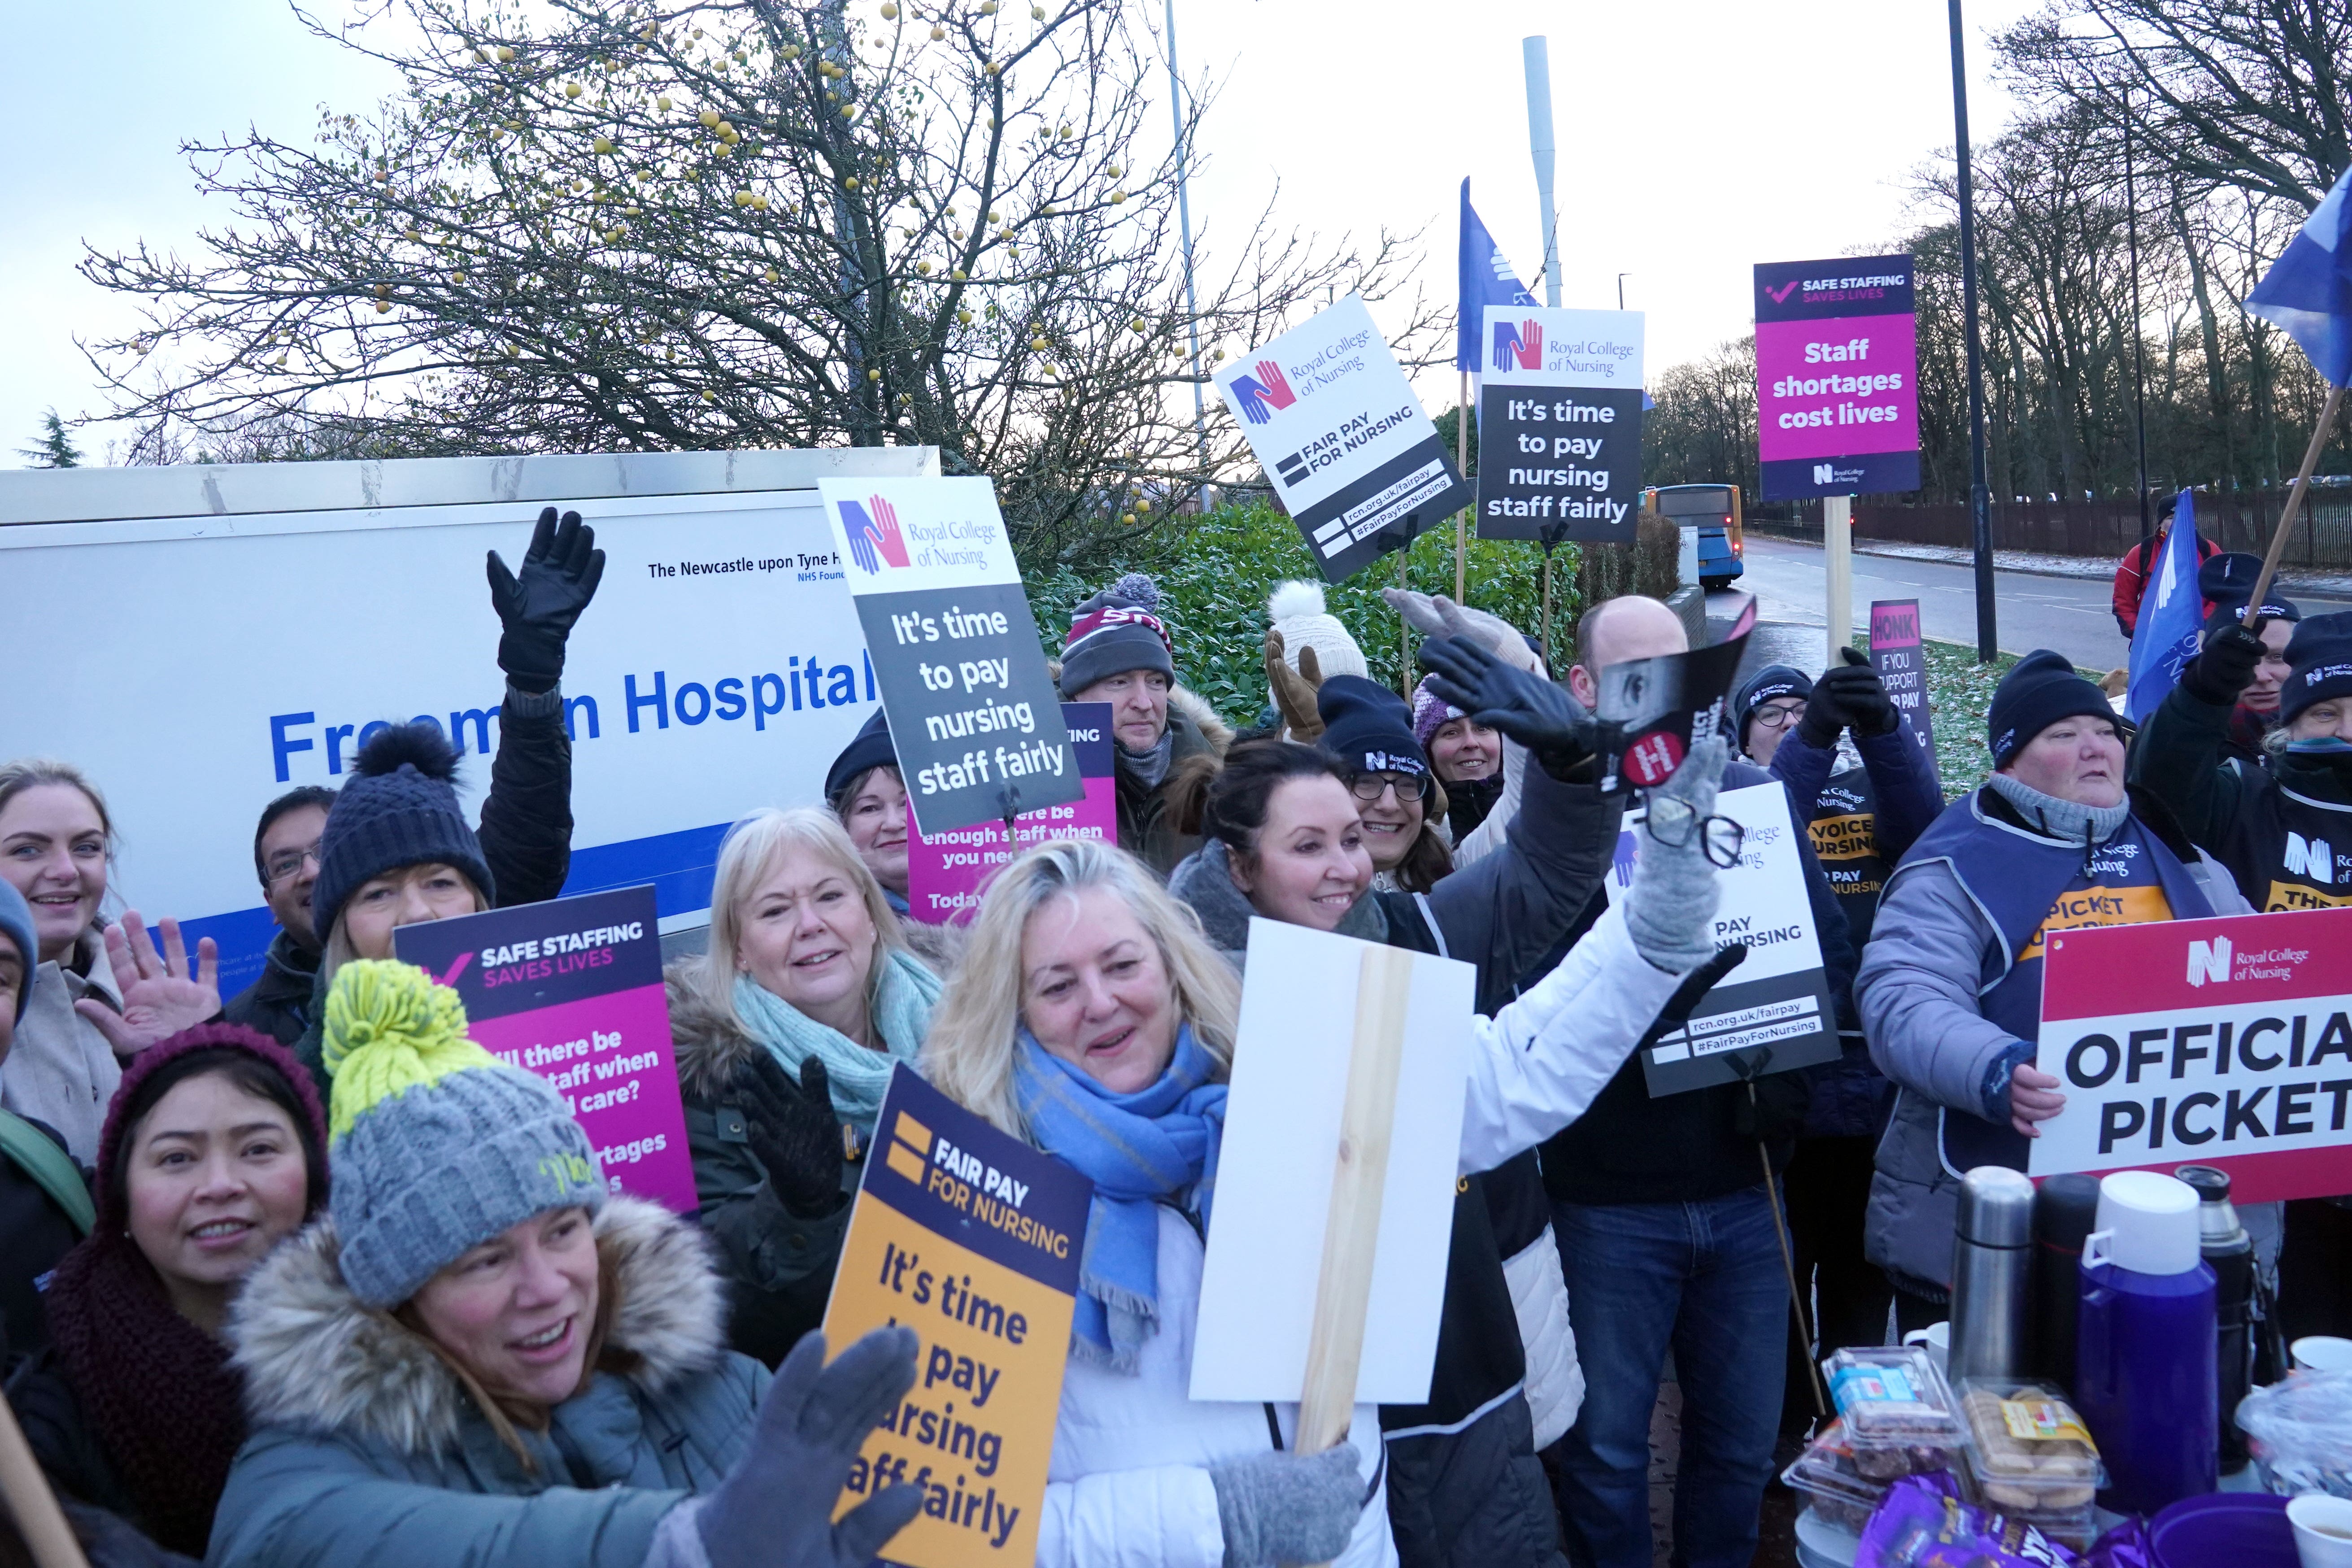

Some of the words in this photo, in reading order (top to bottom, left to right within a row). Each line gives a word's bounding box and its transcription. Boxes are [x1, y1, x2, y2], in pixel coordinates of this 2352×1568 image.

[1803, 279, 1838, 291] SAFE
[1840, 274, 1905, 289] STAFFING
[1803, 291, 1844, 303] SAVES
[1848, 288, 1884, 300] LIVES
[1291, 352, 1326, 380] Royal
[1326, 330, 1371, 359] College
[1551, 341, 1584, 359] Royal
[1588, 342, 1633, 360] College
[1804, 338, 1870, 364] Staff
[1302, 379, 1315, 396] of
[1315, 356, 1364, 388] Nursing
[1549, 359, 1561, 371] of
[1567, 360, 1614, 377] Nursing
[1773, 373, 1902, 398] shortages
[1508, 400, 1546, 421] It's
[1554, 400, 1615, 423] time
[1779, 406, 1833, 429] cost
[1838, 401, 1898, 425] lives
[1303, 432, 1339, 459] FAIR
[1340, 412, 1369, 437] PAY
[1310, 448, 1342, 473] FOR
[1344, 406, 1413, 452] NURSING
[1518, 434, 1546, 453] to
[1554, 437, 1603, 459] pay
[1509, 464, 1609, 492] nursing
[1348, 469, 1430, 520] rcn.org.uk/fairpay
[1356, 479, 1447, 536] #FairPayForNursing
[1488, 496, 1553, 517] staff
[1559, 496, 1629, 524] fairly
[908, 522, 947, 547] Royal
[950, 521, 996, 544] College
[649, 564, 675, 578] The
[681, 557, 754, 575] Newcastle
[759, 557, 793, 573] upon
[797, 554, 828, 570] Tyne
[918, 549, 932, 567] of
[934, 547, 988, 570] Nursing
[797, 572, 817, 582] NHS
[891, 610, 940, 645] It's
[942, 605, 1009, 639] time
[1874, 614, 1916, 641] HONK
[919, 662, 953, 691] to
[959, 658, 1009, 693] pay
[1882, 655, 1889, 671] IF
[1890, 653, 1909, 669] YOU
[1878, 672, 1918, 691] UPPORT
[1901, 691, 1919, 709] PAY
[926, 698, 1035, 741] nursing
[270, 695, 600, 782] Frmn
[918, 750, 989, 795] staff
[994, 740, 1063, 779] fairly
[1831, 788, 1866, 804] College
[922, 828, 997, 847] enough
[1002, 824, 1047, 842] staff
[1050, 824, 1103, 839] when
[1740, 827, 1780, 845] ollege
[1812, 819, 1873, 838] VOICE
[942, 853, 979, 869] you
[1832, 870, 1861, 882] PAY
[2045, 896, 2123, 919] PICKET
[1715, 916, 1751, 936] PAY
[482, 941, 540, 968] SAFE
[542, 922, 643, 957] STAFFING
[2236, 949, 2267, 965] Royal
[2268, 948, 2309, 964] College
[483, 959, 553, 988] SAVES
[557, 948, 613, 975] LIVES
[2234, 968, 2249, 982] of
[2249, 966, 2291, 982] Nursing
[1693, 1002, 1801, 1031] rcn.org.uk/fairpay
[524, 1034, 588, 1068] there
[592, 1030, 622, 1054] be
[1697, 1019, 1816, 1052] #FairPayForNursing
[548, 1061, 591, 1091] taff
[593, 1050, 659, 1080] when
[580, 1080, 640, 1114] care?
[2098, 1078, 2352, 1154] PICKET
[934, 1138, 983, 1187] FAIR
[984, 1166, 1029, 1208] PAY
[928, 1168, 970, 1211] FOR
[973, 1193, 1069, 1259] NURSING
[880, 1242, 933, 1305] It's
[941, 1275, 1028, 1345] time
[924, 1343, 1001, 1407] pay
